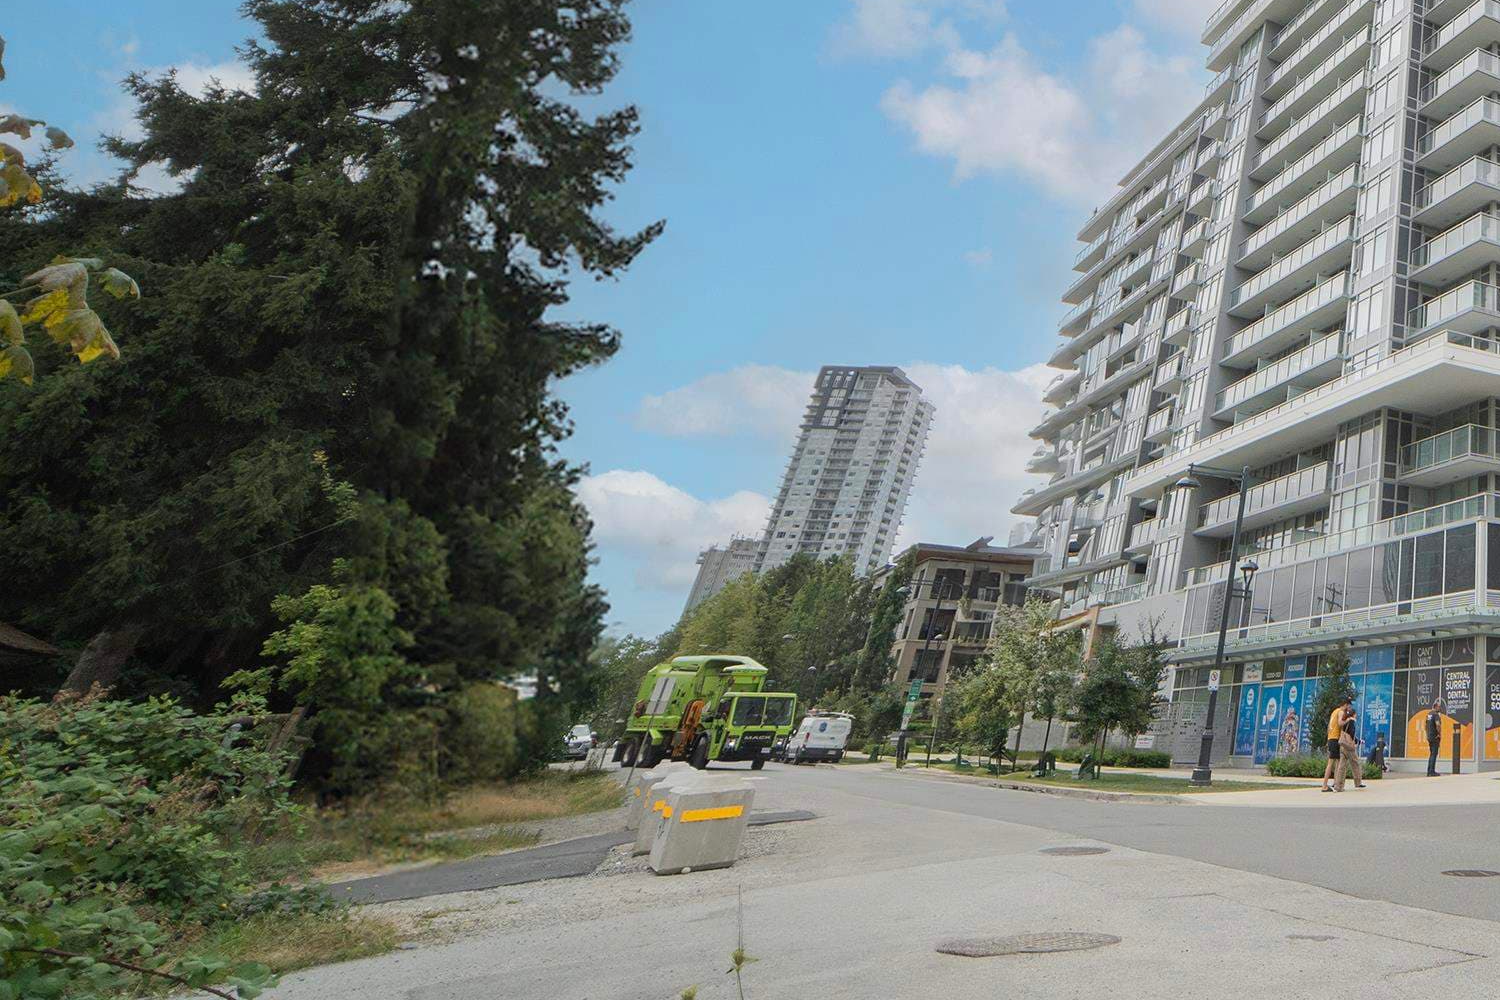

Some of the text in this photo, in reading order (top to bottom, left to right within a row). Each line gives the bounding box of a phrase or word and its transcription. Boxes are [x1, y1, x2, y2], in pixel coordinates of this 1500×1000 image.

[1417, 657, 1432, 666] WAIT
[1418, 673, 1427, 682] TO
[1446, 672, 1470, 680] CENTRAL
[1417, 684, 1433, 693] MEET
[1445, 680, 1471, 690] SURREY
[1447, 690, 1468, 699] DENTAL
[1417, 695, 1430, 705] YOU
